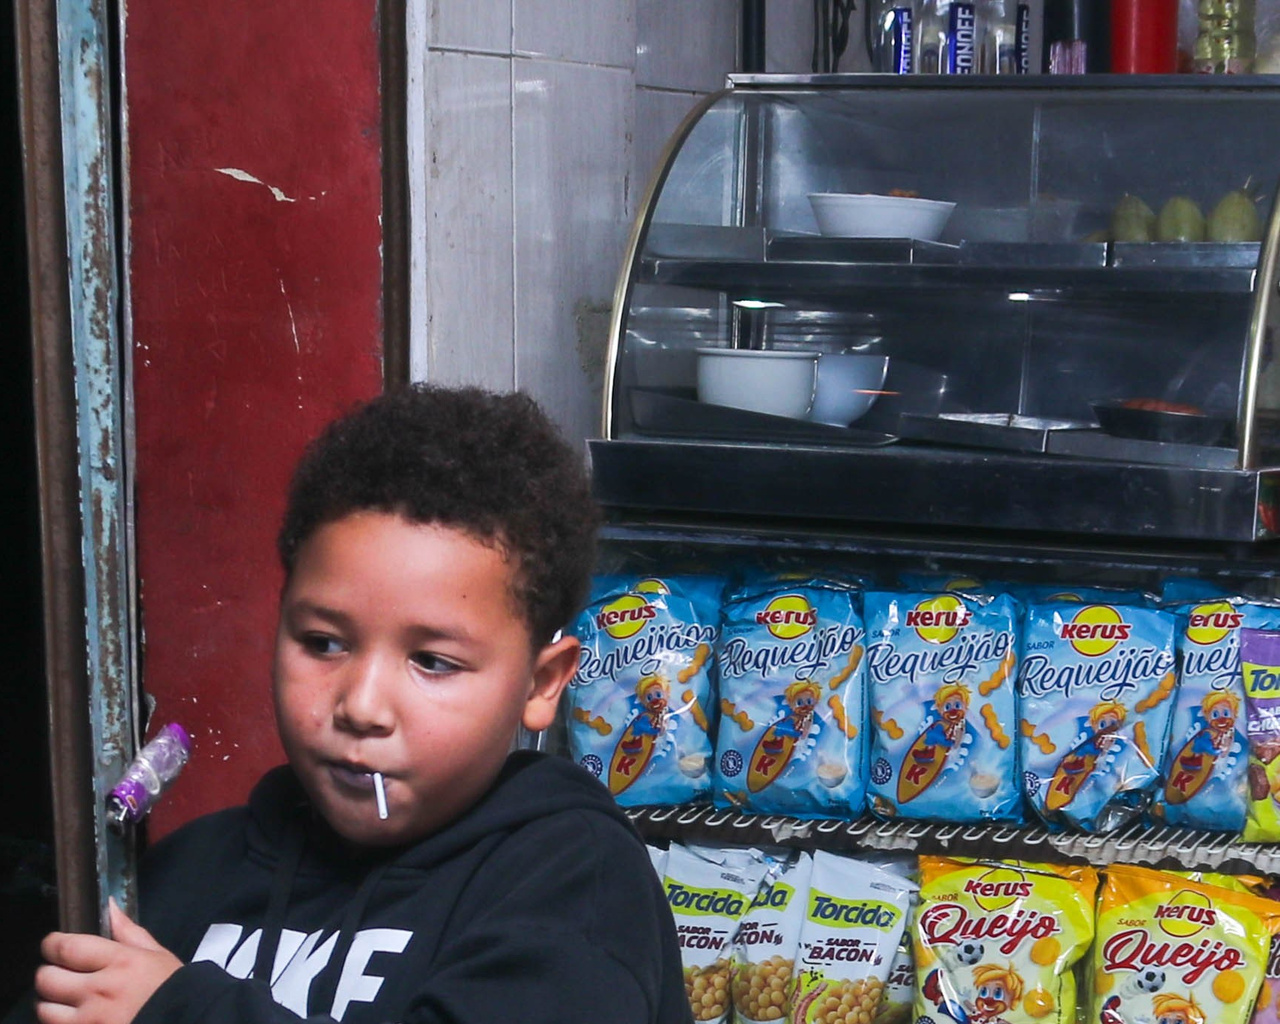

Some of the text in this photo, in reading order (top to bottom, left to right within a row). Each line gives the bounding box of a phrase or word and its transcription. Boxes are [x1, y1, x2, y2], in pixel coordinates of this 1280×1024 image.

[872, 628, 901, 639] SAOR
[1188, 613, 1245, 629] erus
[720, 625, 864, 681] Requeijão
[867, 631, 1015, 684] Requeijão
[1026, 640, 1056, 651] SABOR
[1020, 648, 1176, 702] Requeijão
[666, 884, 744, 916] Torcida
[811, 896, 896, 928] Torcida
[679, 935, 725, 950] ACON
[825, 938, 862, 948] SABOR
[920, 904, 1061, 954] Queijo
[808, 946, 874, 962] BACON
[1103, 929, 1247, 985] Queijo
